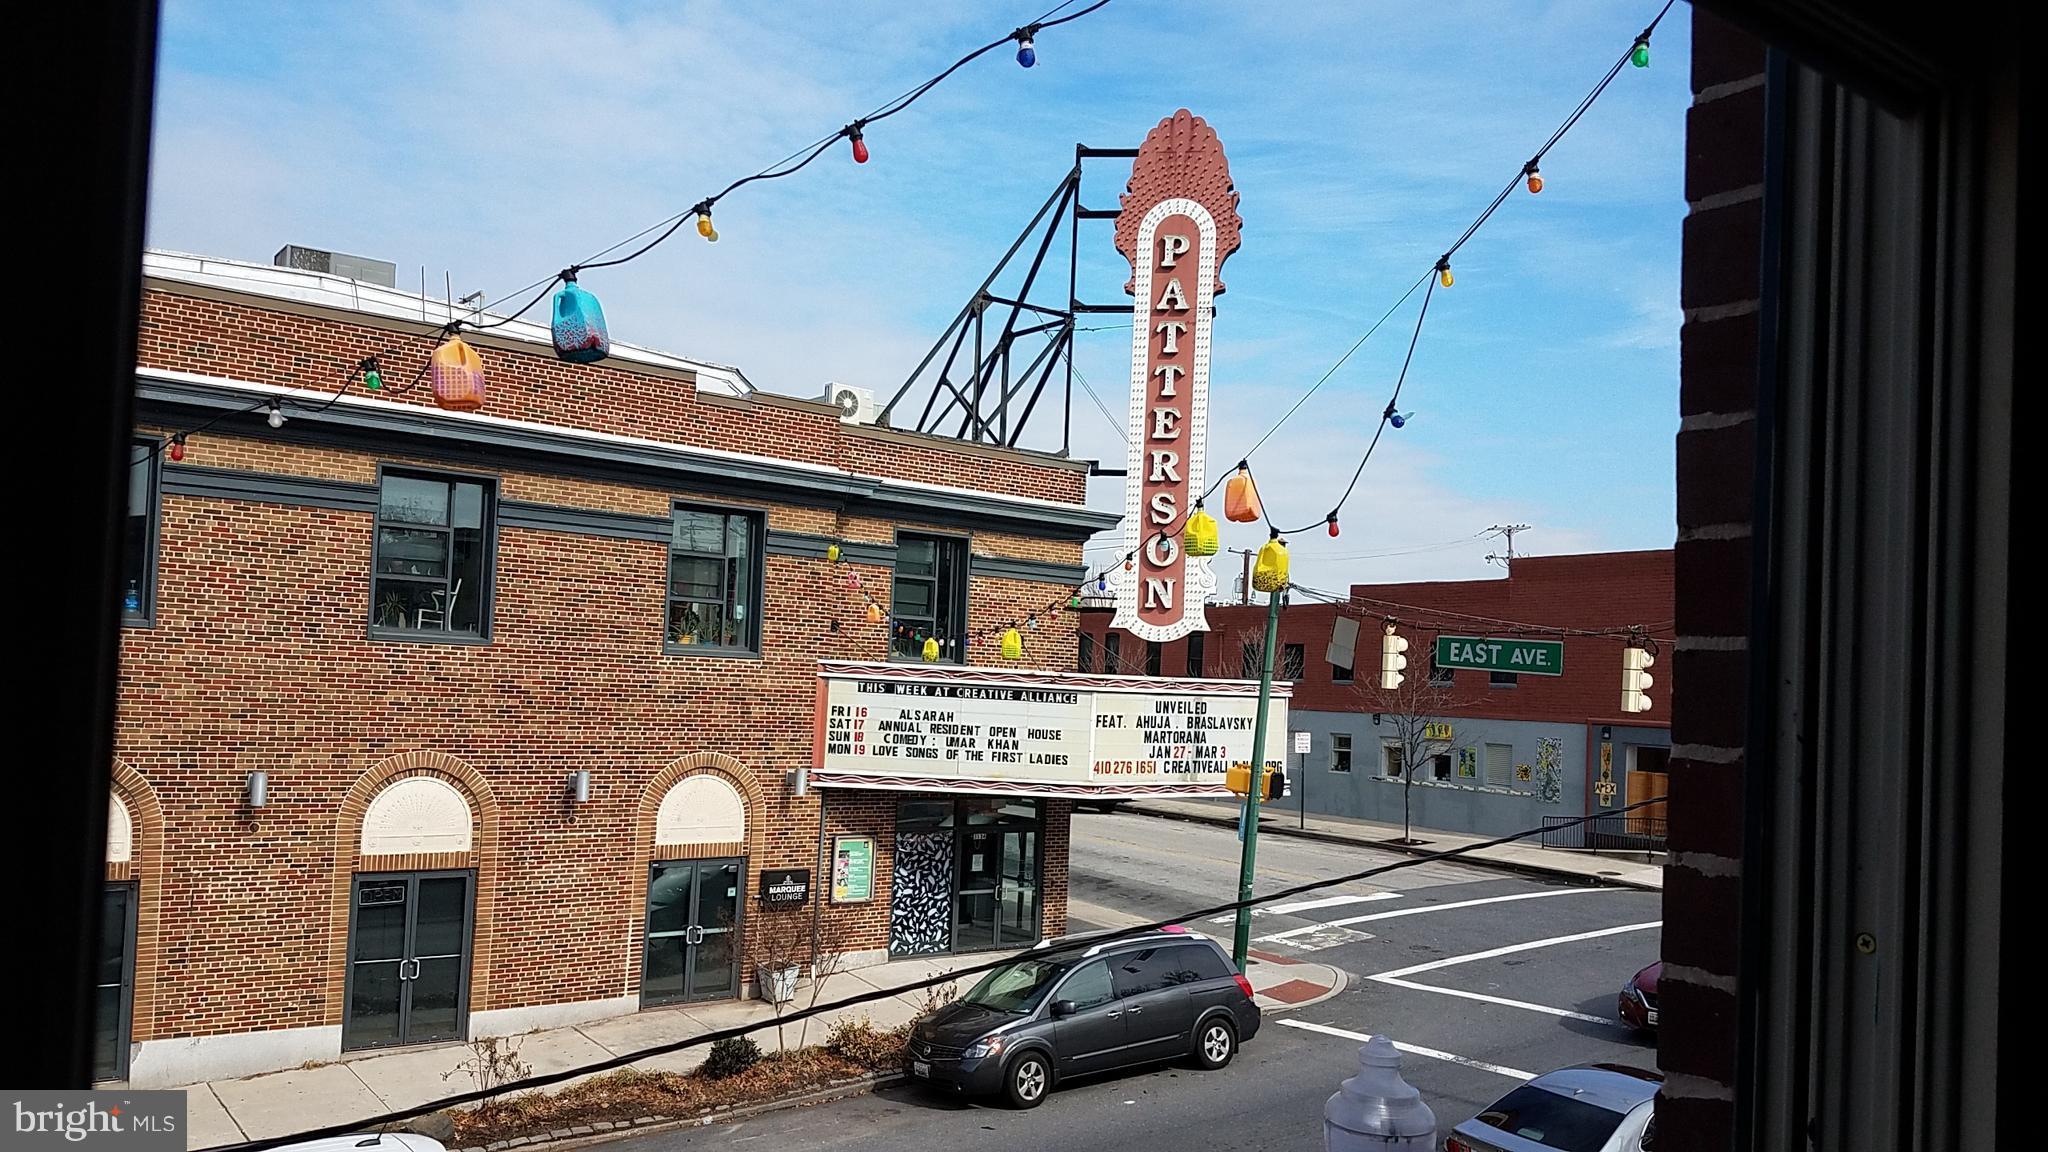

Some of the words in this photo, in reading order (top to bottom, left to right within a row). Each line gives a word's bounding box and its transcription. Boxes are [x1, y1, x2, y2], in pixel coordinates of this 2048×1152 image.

[1144, 234, 1189, 611] PATTERSON
[1449, 642, 1502, 665] EAST
[1510, 648, 1551, 666] AVE.
[859, 682, 885, 693] THIS
[896, 685, 928, 696] WEEK
[934, 687, 950, 697] AT
[956, 688, 1014, 700] CREATIVE
[1020, 691, 1077, 704] ALLIANCE
[831, 706, 851, 717] FRI
[855, 707, 868, 718] 16
[899, 709, 954, 722] ALSARAH
[1155, 700, 1207, 715] UNVEILED
[829, 719, 851, 729] SAT
[854, 719, 865, 730] 17
[878, 720, 922, 733] ANNUAL
[930, 723, 981, 736] RESIDENT
[989, 726, 1017, 738] OPEN
[1027, 728, 1062, 741] HOUSE
[1095, 714, 1127, 729] FEAT.
[1187, 716, 1253, 730] BRASLAVSKY
[828, 731, 850, 742] SUN
[854, 732, 864, 742] 18
[945, 736, 976, 748] UMAR
[987, 738, 1019, 750] KHAN
[1143, 730, 1207, 744] MARTORANA
[828, 743, 851, 755] MON
[854, 744, 866, 755] 19
[872, 745, 898, 757] LOVE
[905, 746, 938, 759] SONGS
[946, 749, 959, 760] OF
[965, 750, 984, 761] THE
[991, 751, 1023, 763] FIRST
[1029, 753, 1069, 765] LADIES
[1149, 745, 1171, 759] JAN
[1195, 746, 1217, 759] MAR
[1220, 746, 1227, 759] 3
[1093, 761, 1111, 774] 410
[1113, 761, 1132, 774] 276
[1136, 761, 1157, 774] 1651
[769, 885, 806, 894] MARQUEE
[771, 893, 803, 901] LOUNGE
